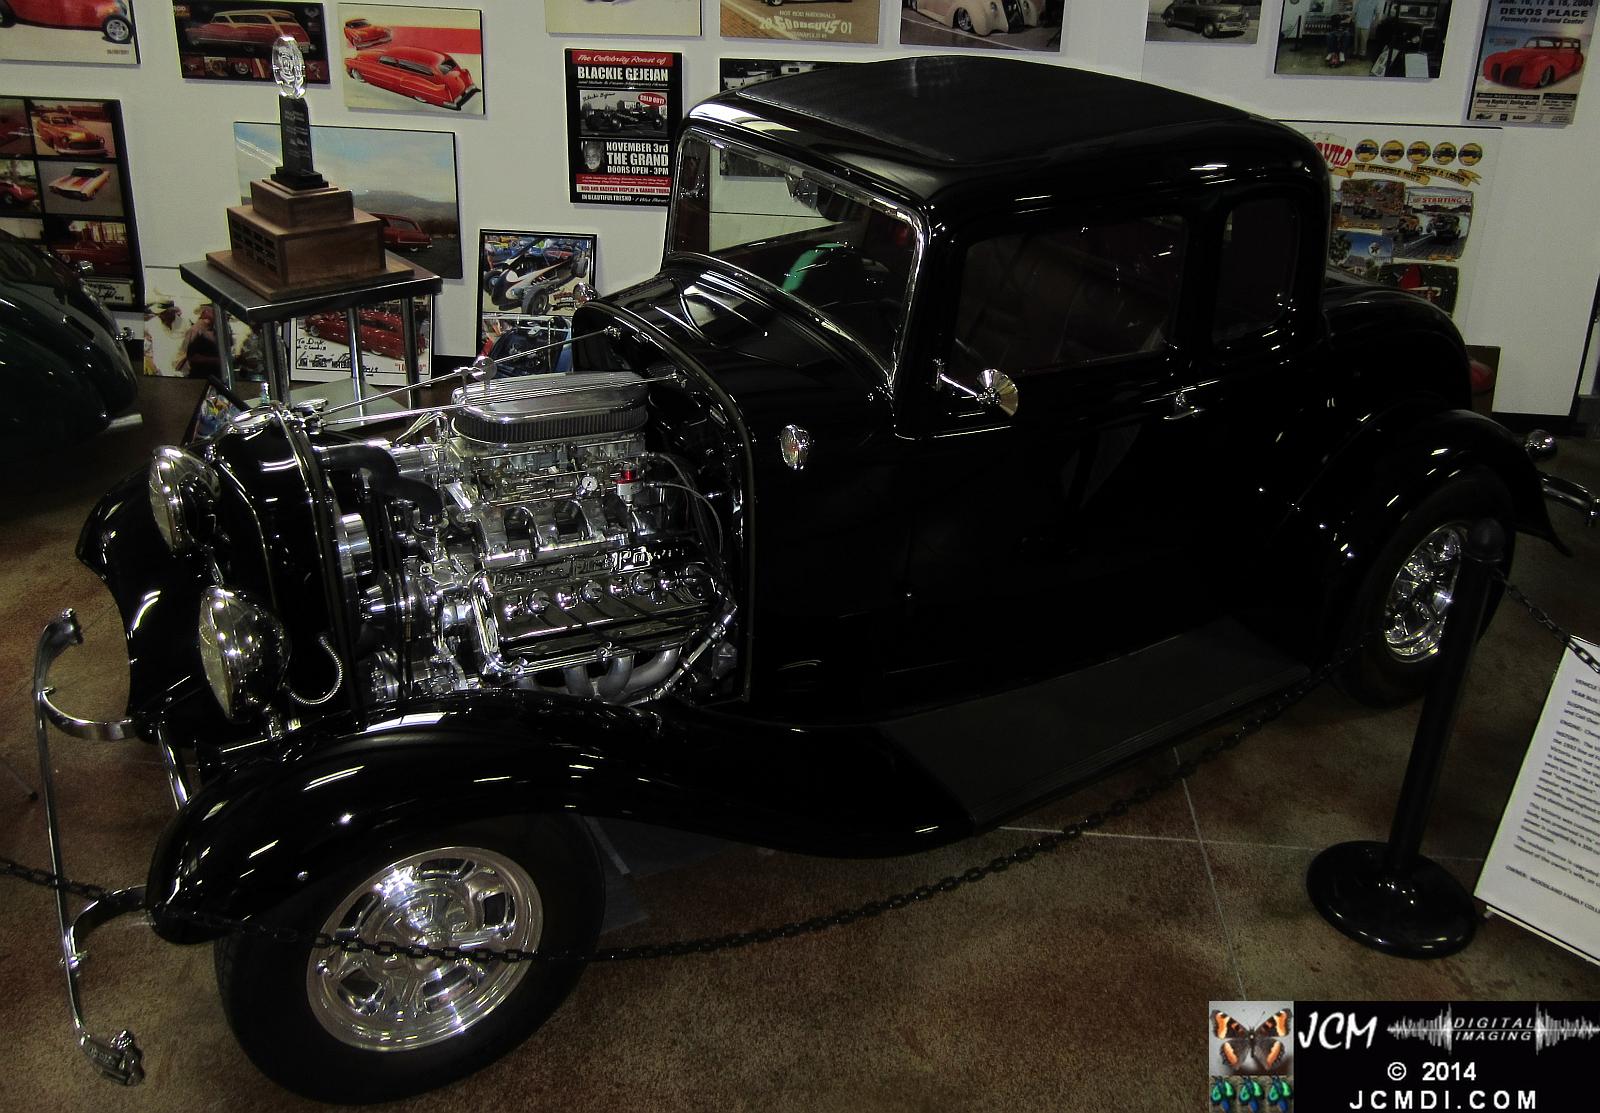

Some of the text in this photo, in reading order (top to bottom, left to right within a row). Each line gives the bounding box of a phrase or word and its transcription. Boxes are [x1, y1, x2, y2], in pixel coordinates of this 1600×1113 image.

[1500, 7, 1589, 18] DEVOS PLACE
[1500, 16, 1528, 24] Formerly
[840, 22, 852, 34] 01
[577, 54, 667, 65] The Celebrity Roast of
[577, 66, 623, 80] BLACKIE
[639, 94, 665, 105] SOLD OUT!
[606, 141, 668, 153] NOVEMBER 3rd
[606, 152, 669, 167] THE GRAND
[607, 165, 631, 174] DOORS
[631, 166, 649, 175] OPEN
[653, 167, 669, 175] 3PM
